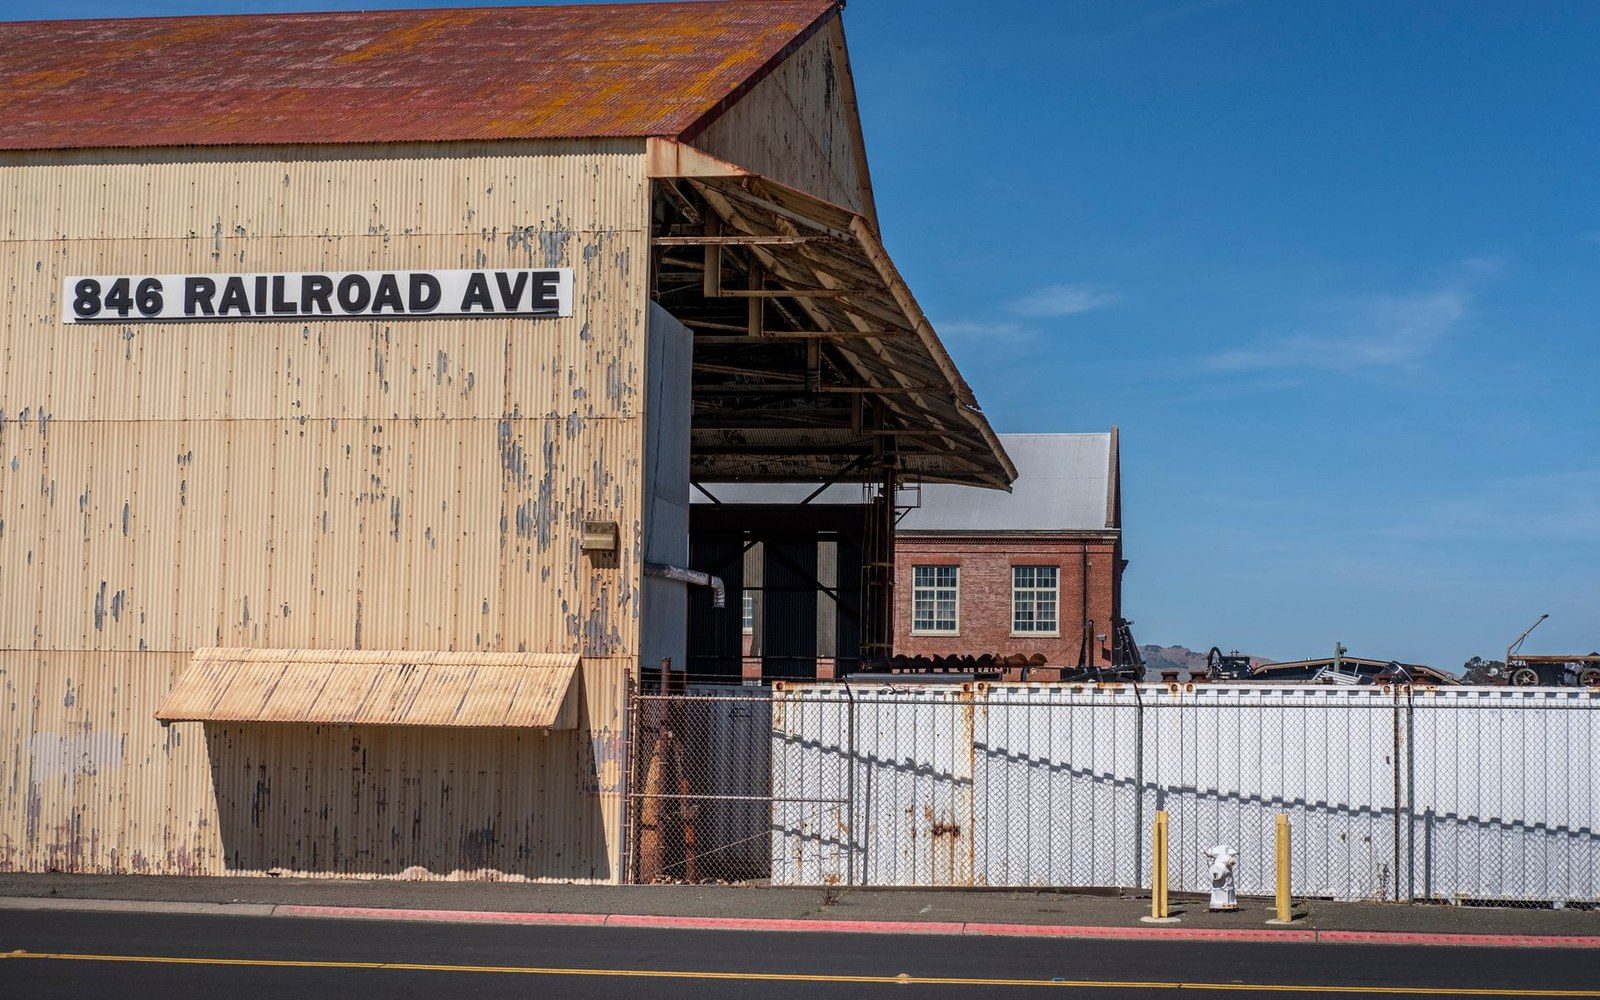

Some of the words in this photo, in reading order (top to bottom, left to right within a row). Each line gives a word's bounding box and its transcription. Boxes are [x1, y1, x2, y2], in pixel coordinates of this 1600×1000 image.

[74, 278, 164, 315] 846
[184, 273, 441, 314] RAILROAD
[461, 271, 560, 311] AVE
